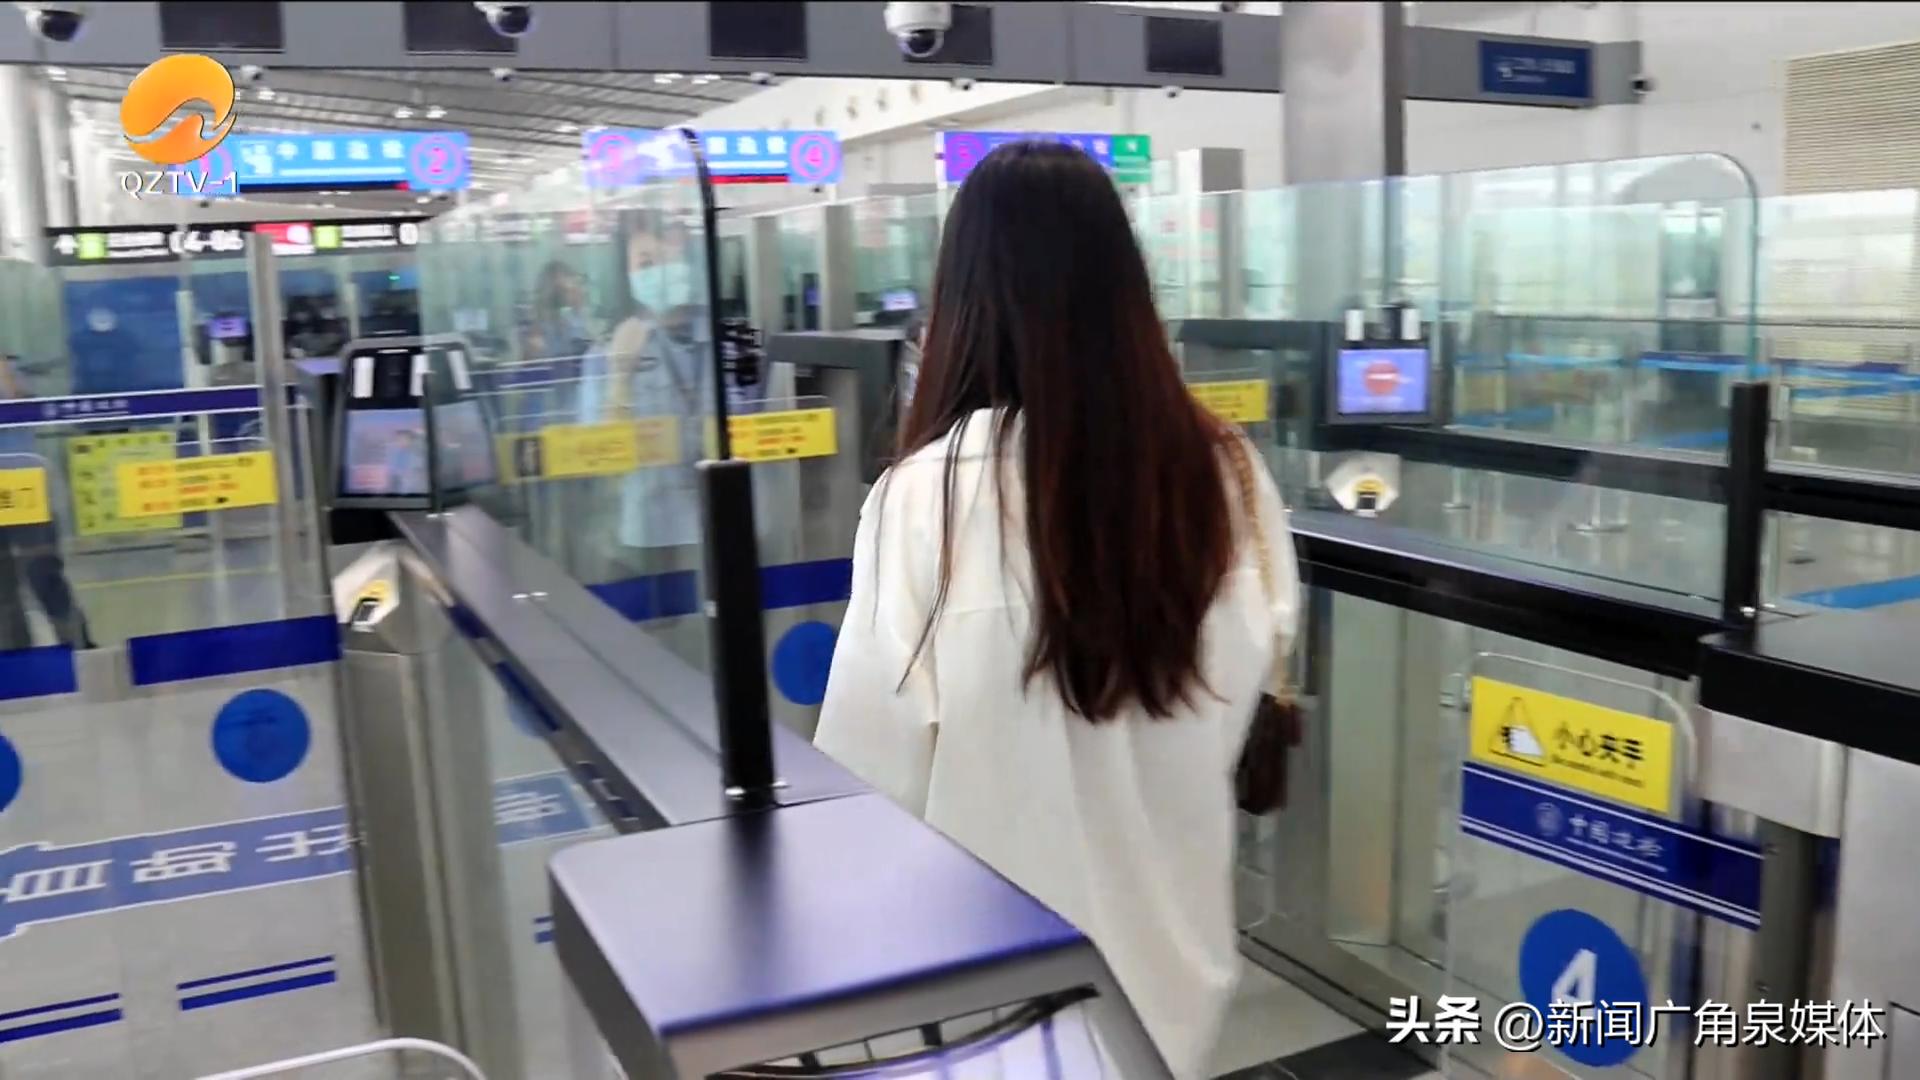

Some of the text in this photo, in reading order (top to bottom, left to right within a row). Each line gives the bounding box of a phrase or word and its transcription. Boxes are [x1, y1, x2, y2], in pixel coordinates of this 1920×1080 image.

[1552, 720, 1646, 770] 小心夹手
[1550, 948, 1599, 1033] 4
